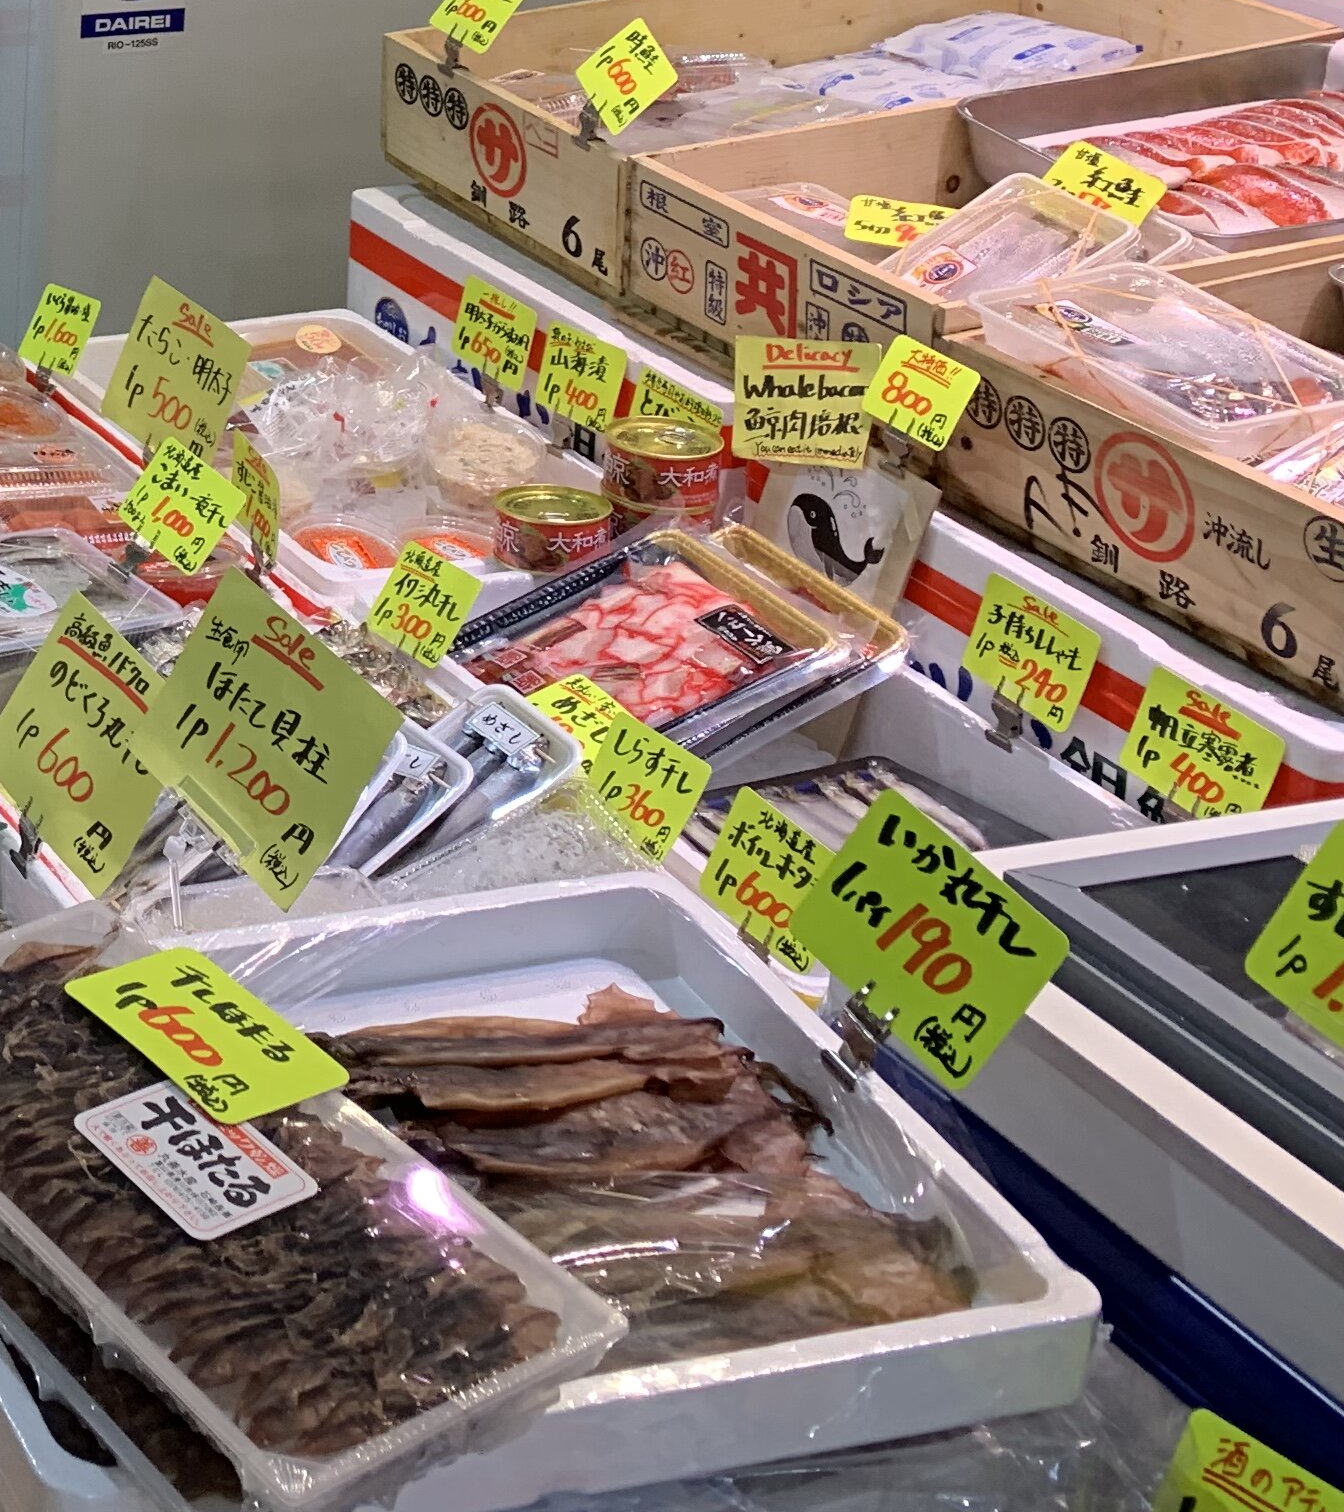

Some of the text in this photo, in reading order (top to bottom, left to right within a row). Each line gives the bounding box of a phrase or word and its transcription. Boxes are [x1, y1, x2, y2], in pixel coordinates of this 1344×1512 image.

[95, 14, 171, 33] DAIREI
[607, 58, 637, 95] 600
[561, 215, 583, 258] 6
[179, 302, 213, 339] Sale
[470, 331, 502, 364] 650
[765, 343, 853, 366] Delicacy
[148, 376, 192, 430] 500
[564, 379, 599, 411] 400
[744, 375, 815, 400] Whale
[881, 372, 933, 417] 800
[1203, 513, 1271, 571] 沖流し
[391, 603, 431, 639] 300
[1023, 596, 1059, 624] Sale
[1260, 601, 1298, 659] 6
[264, 615, 317, 672] Sale
[1015, 659, 1068, 703] 240
[175, 703, 208, 749] 1p
[206, 662, 328, 785] ほたて貝柱
[1185, 690, 1232, 725] Sale
[37, 727, 94, 803] 600
[614, 729, 693, 794] しらす干し
[1136, 735, 1160, 768] 1p
[1170, 752, 1225, 804] 400
[618, 784, 665, 827] 360
[736, 870, 794, 929] 600
[878, 814, 1037, 957] いか丸干し
[877, 903, 972, 994] 190
[138, 1005, 223, 1067] 600
